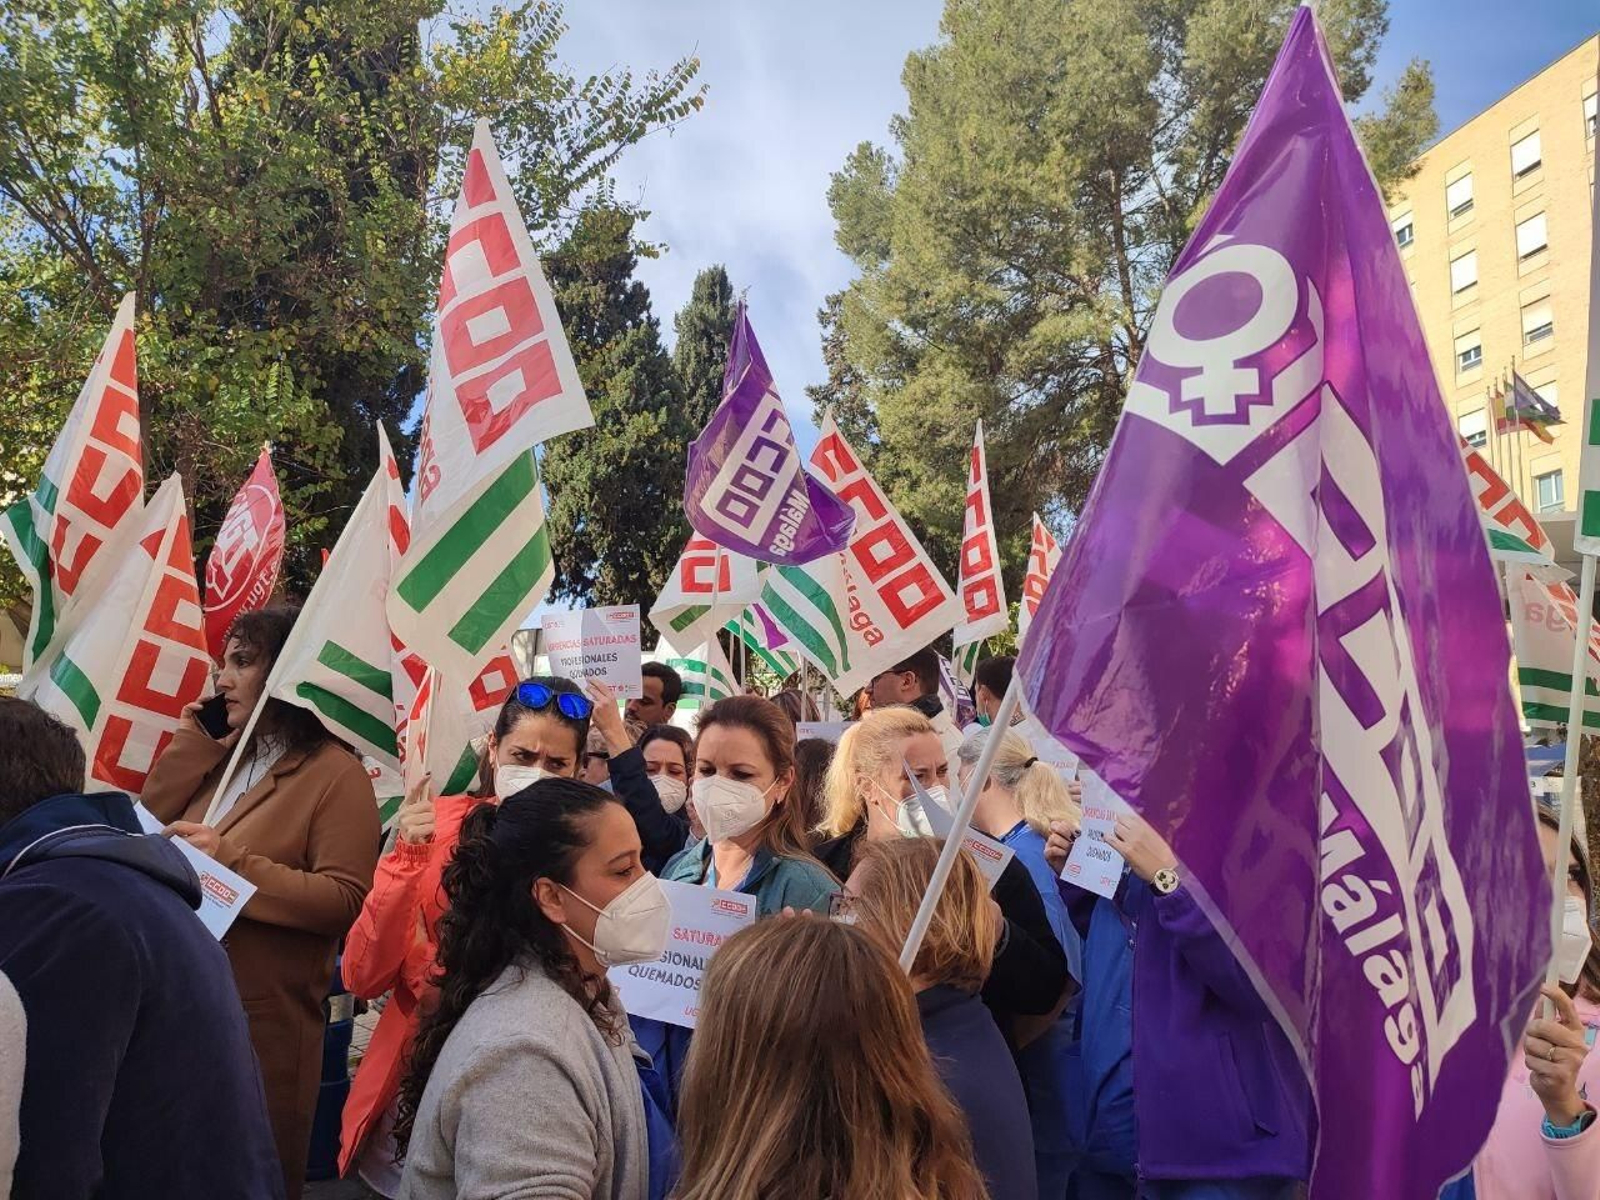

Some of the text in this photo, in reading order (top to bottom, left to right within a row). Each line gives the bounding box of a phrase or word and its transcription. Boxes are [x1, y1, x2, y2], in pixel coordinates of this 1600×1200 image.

[768, 487, 811, 557] Málaga
[583, 634, 637, 647] SATURADAS
[673, 927, 725, 946] SATURA
[628, 965, 700, 990] QUEMADOS
